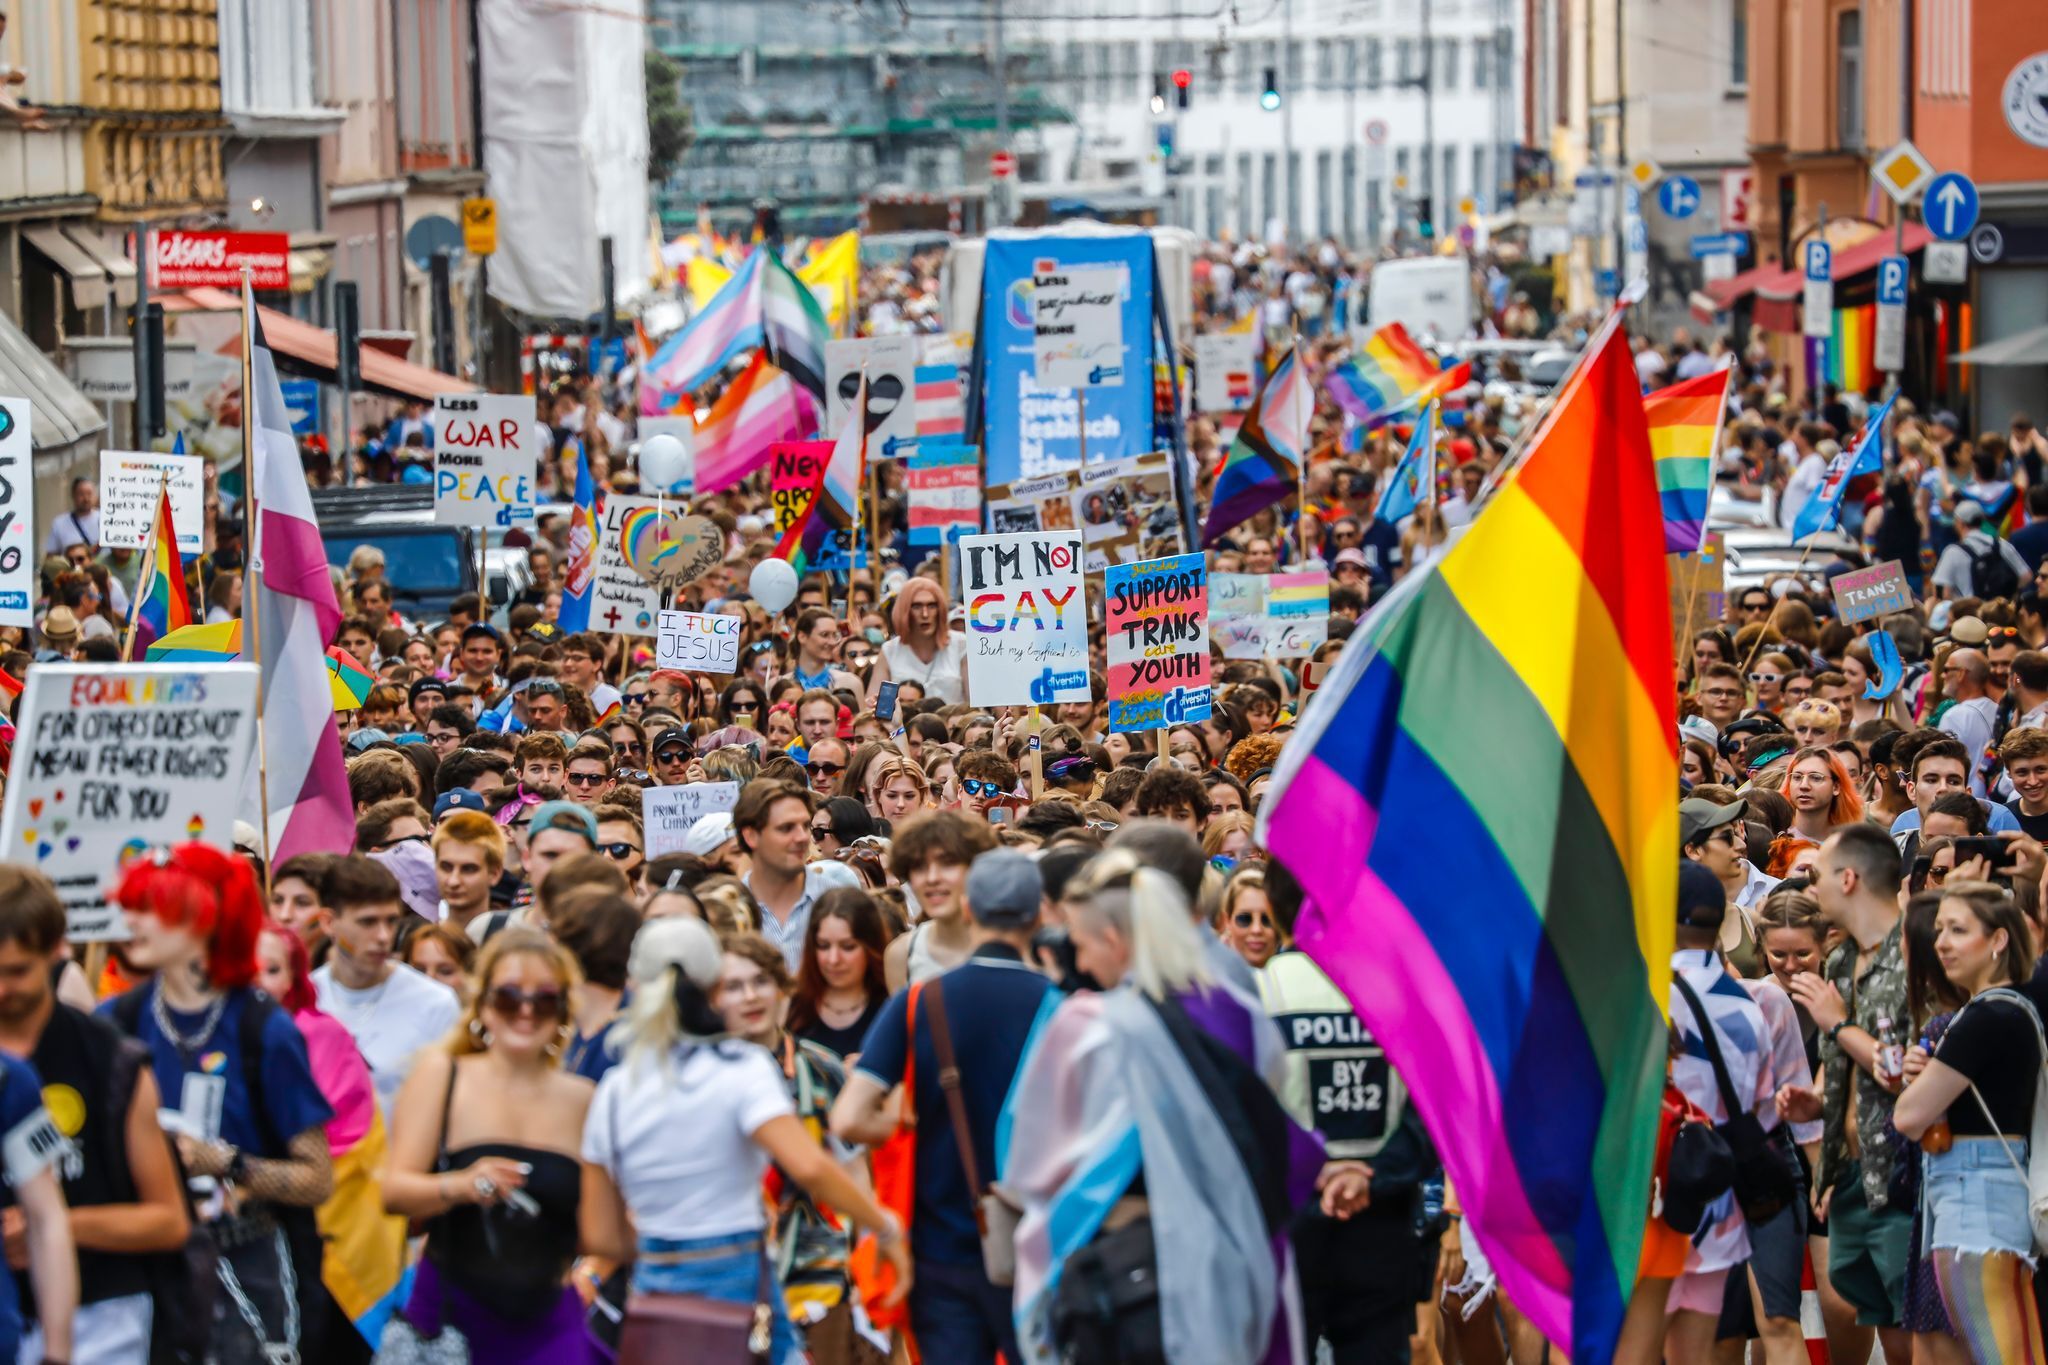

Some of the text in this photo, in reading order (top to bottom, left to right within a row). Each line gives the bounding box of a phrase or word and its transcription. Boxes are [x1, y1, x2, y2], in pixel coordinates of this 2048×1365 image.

[444, 419, 520, 450] WAR
[438, 470, 529, 503] PEACE
[967, 543, 1024, 590] I'M
[1112, 568, 1202, 615] SUPPORT
[660, 613, 738, 635] I FUCK
[969, 586, 1077, 633] GAY
[1121, 611, 1201, 650] TRANS
[661, 633, 735, 662] JESUS
[977, 636, 1003, 656] But
[1008, 648, 1025, 662] my
[1145, 644, 1177, 657] care
[1129, 652, 1201, 687] YOUTH
[71, 674, 135, 707] EQUAL
[36, 709, 241, 742] FOR OTHERS DOES NOT
[29, 745, 229, 780] MEAN FEWER RIGHTS
[77, 780, 170, 821] FOR YOU
[673, 791, 701, 810] my
[1333, 1060, 1368, 1087] BY
[1317, 1083, 1382, 1113] 5432
